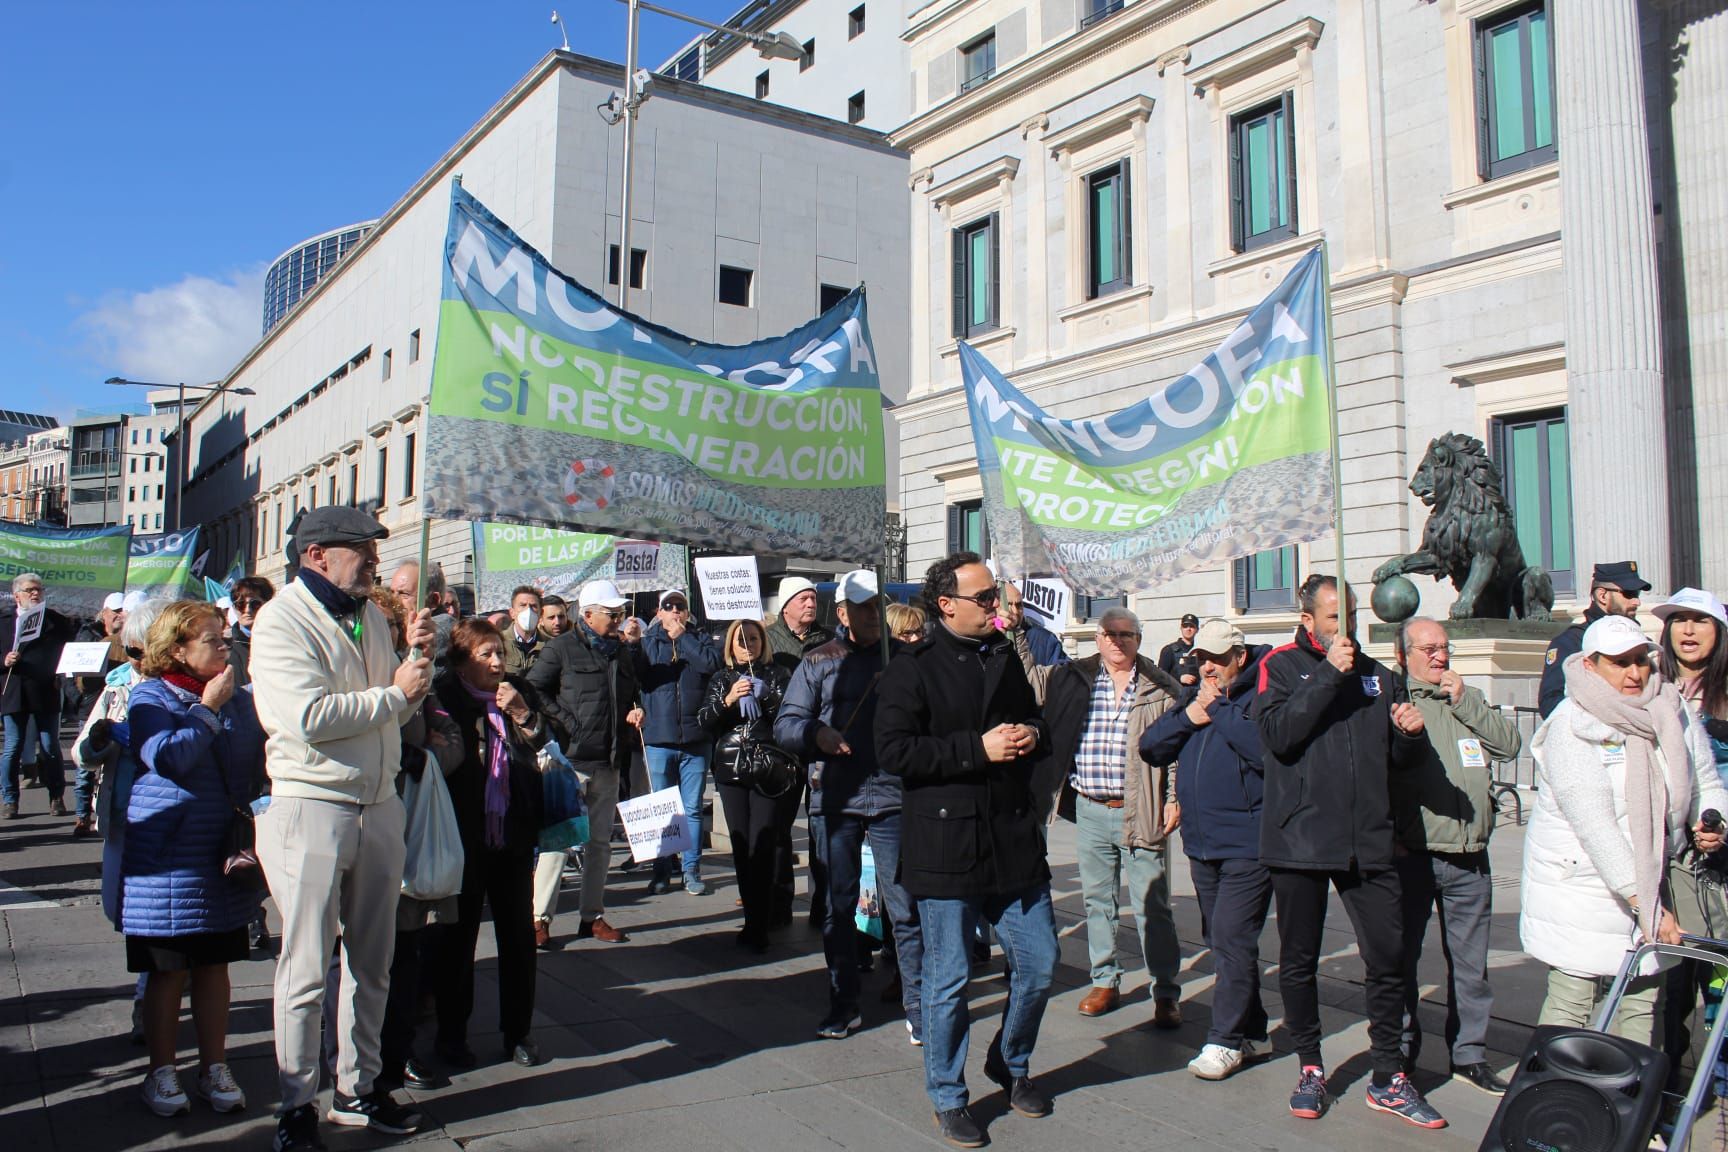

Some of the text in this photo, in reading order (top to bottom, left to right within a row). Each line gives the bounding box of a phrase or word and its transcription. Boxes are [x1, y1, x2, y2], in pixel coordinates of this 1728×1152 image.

[479, 369, 531, 416] SÍ
[491, 527, 527, 544] POR
[26, 549, 117, 568] SOSTENIBLE
[519, 547, 542, 565] DE
[547, 542, 579, 563] LAS
[615, 549, 659, 573] Basta!
[705, 569, 730, 580] Nuestras
[709, 585, 727, 596] tienen
[707, 600, 714, 611] No
[715, 600, 726, 610] más
